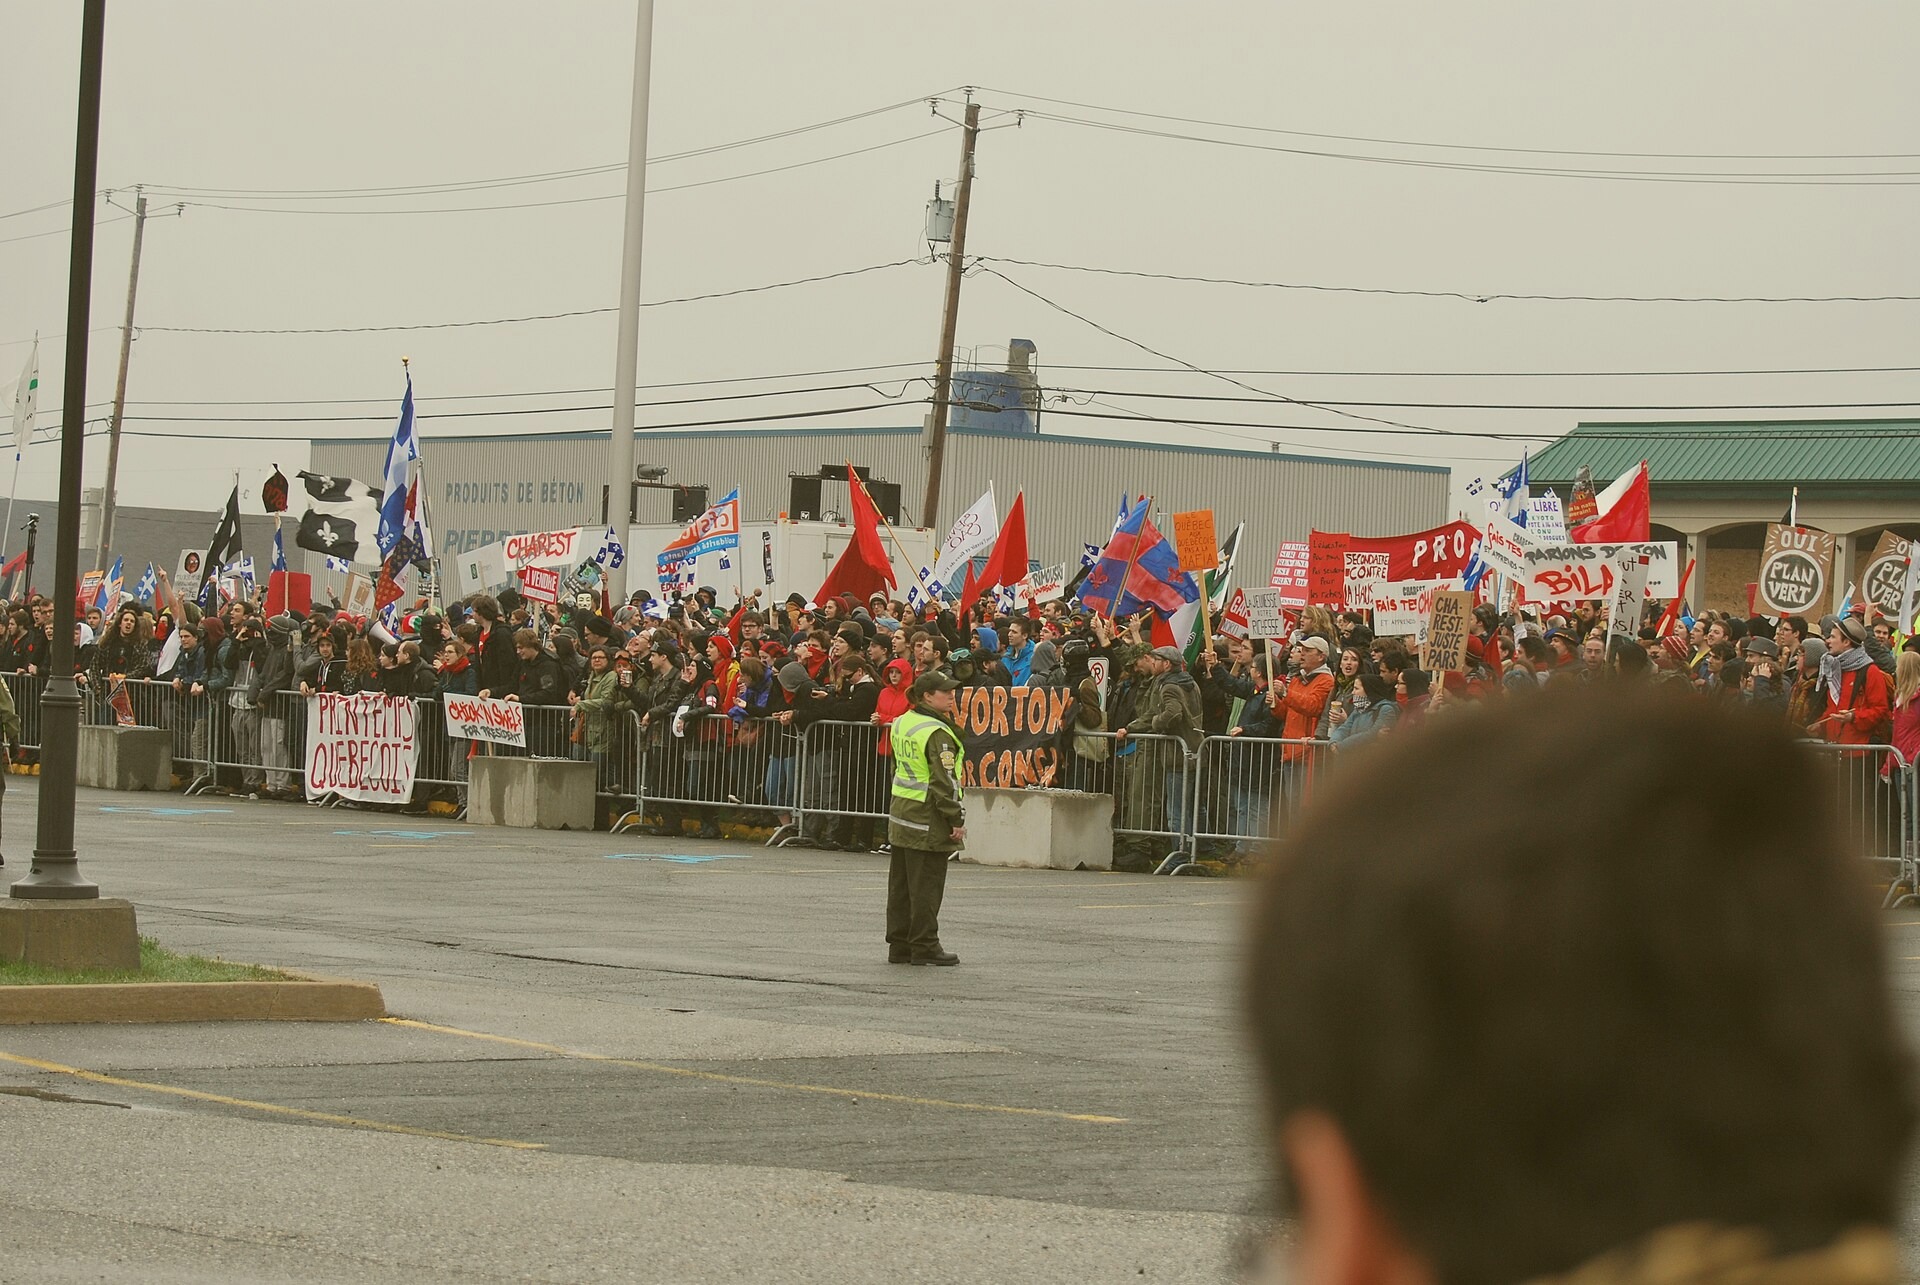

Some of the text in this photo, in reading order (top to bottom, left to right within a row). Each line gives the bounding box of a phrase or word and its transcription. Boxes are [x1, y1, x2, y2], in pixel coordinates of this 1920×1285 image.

[446, 476, 584, 503] PRODUITS DE BÉTON
[1175, 520, 1211, 531] QUÉBEC
[507, 531, 577, 559] CHAREST
[1506, 539, 1522, 557] TES
[1780, 530, 1818, 552] OUI
[1179, 553, 1213, 567] MAFIA
[1346, 553, 1389, 565] SECONDAIRE
[1524, 546, 1596, 566] PARIONS
[531, 570, 557, 592] VENDRE
[1350, 565, 1386, 580] CONTRE
[1770, 561, 1815, 586] PLAN
[1877, 562, 1907, 591] PLA
[1345, 584, 1353, 606] LA
[1768, 581, 1811, 604] VERT
[1871, 579, 1903, 611] VER
[1430, 633, 1464, 650] JUSTE
[1426, 649, 1459, 670] PARS
[318, 693, 414, 743] PRINTEMPS
[461, 724, 481, 738] FOR
